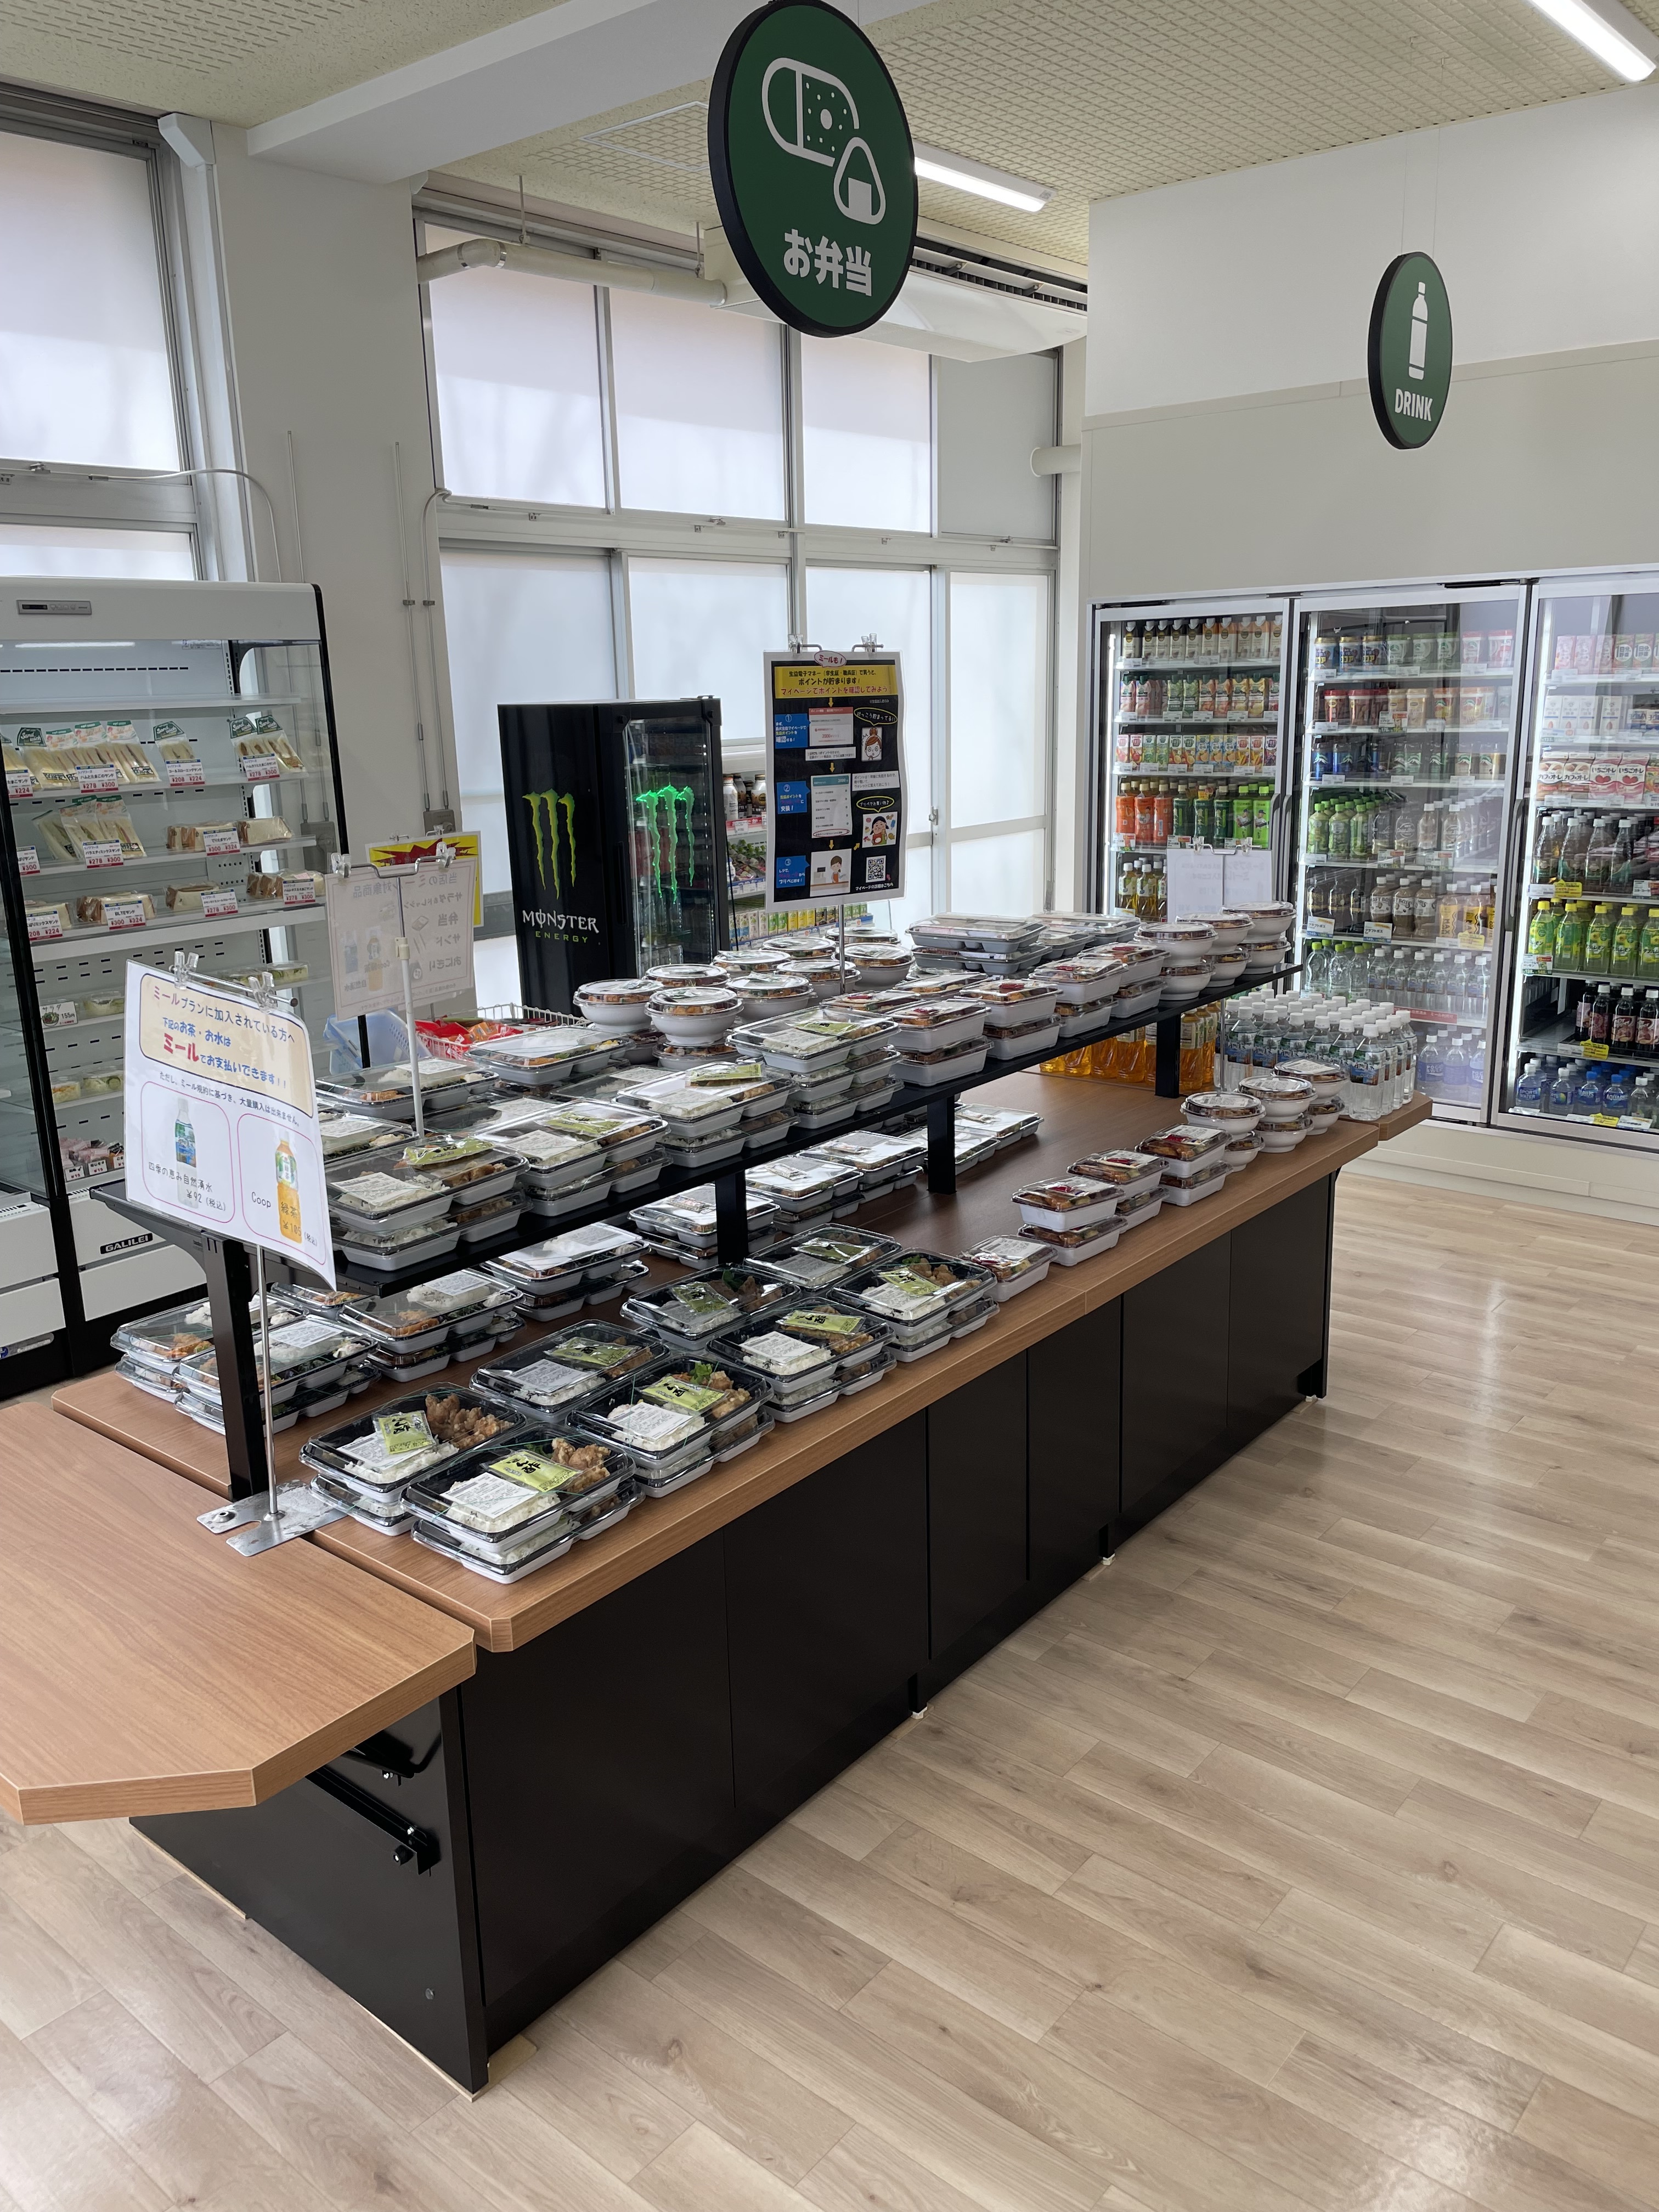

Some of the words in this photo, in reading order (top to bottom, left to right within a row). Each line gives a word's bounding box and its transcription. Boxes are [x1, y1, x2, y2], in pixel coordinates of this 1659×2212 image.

[783, 229, 872, 297] お弁当
[1395, 388, 1432, 421] DRINK
[523, 909, 599, 933] MONSTER
[535, 930, 589, 944] ENERGY
[154, 986, 295, 1043] ミールプランに加入されている方へ
[162, 1017, 232, 1047] 下記のお茶・お水は
[149, 1161, 213, 1193] 四季の恵み自然湧水
[281, 1201, 301, 1219] 緑茶
[106, 1235, 149, 1252] GALILEI
